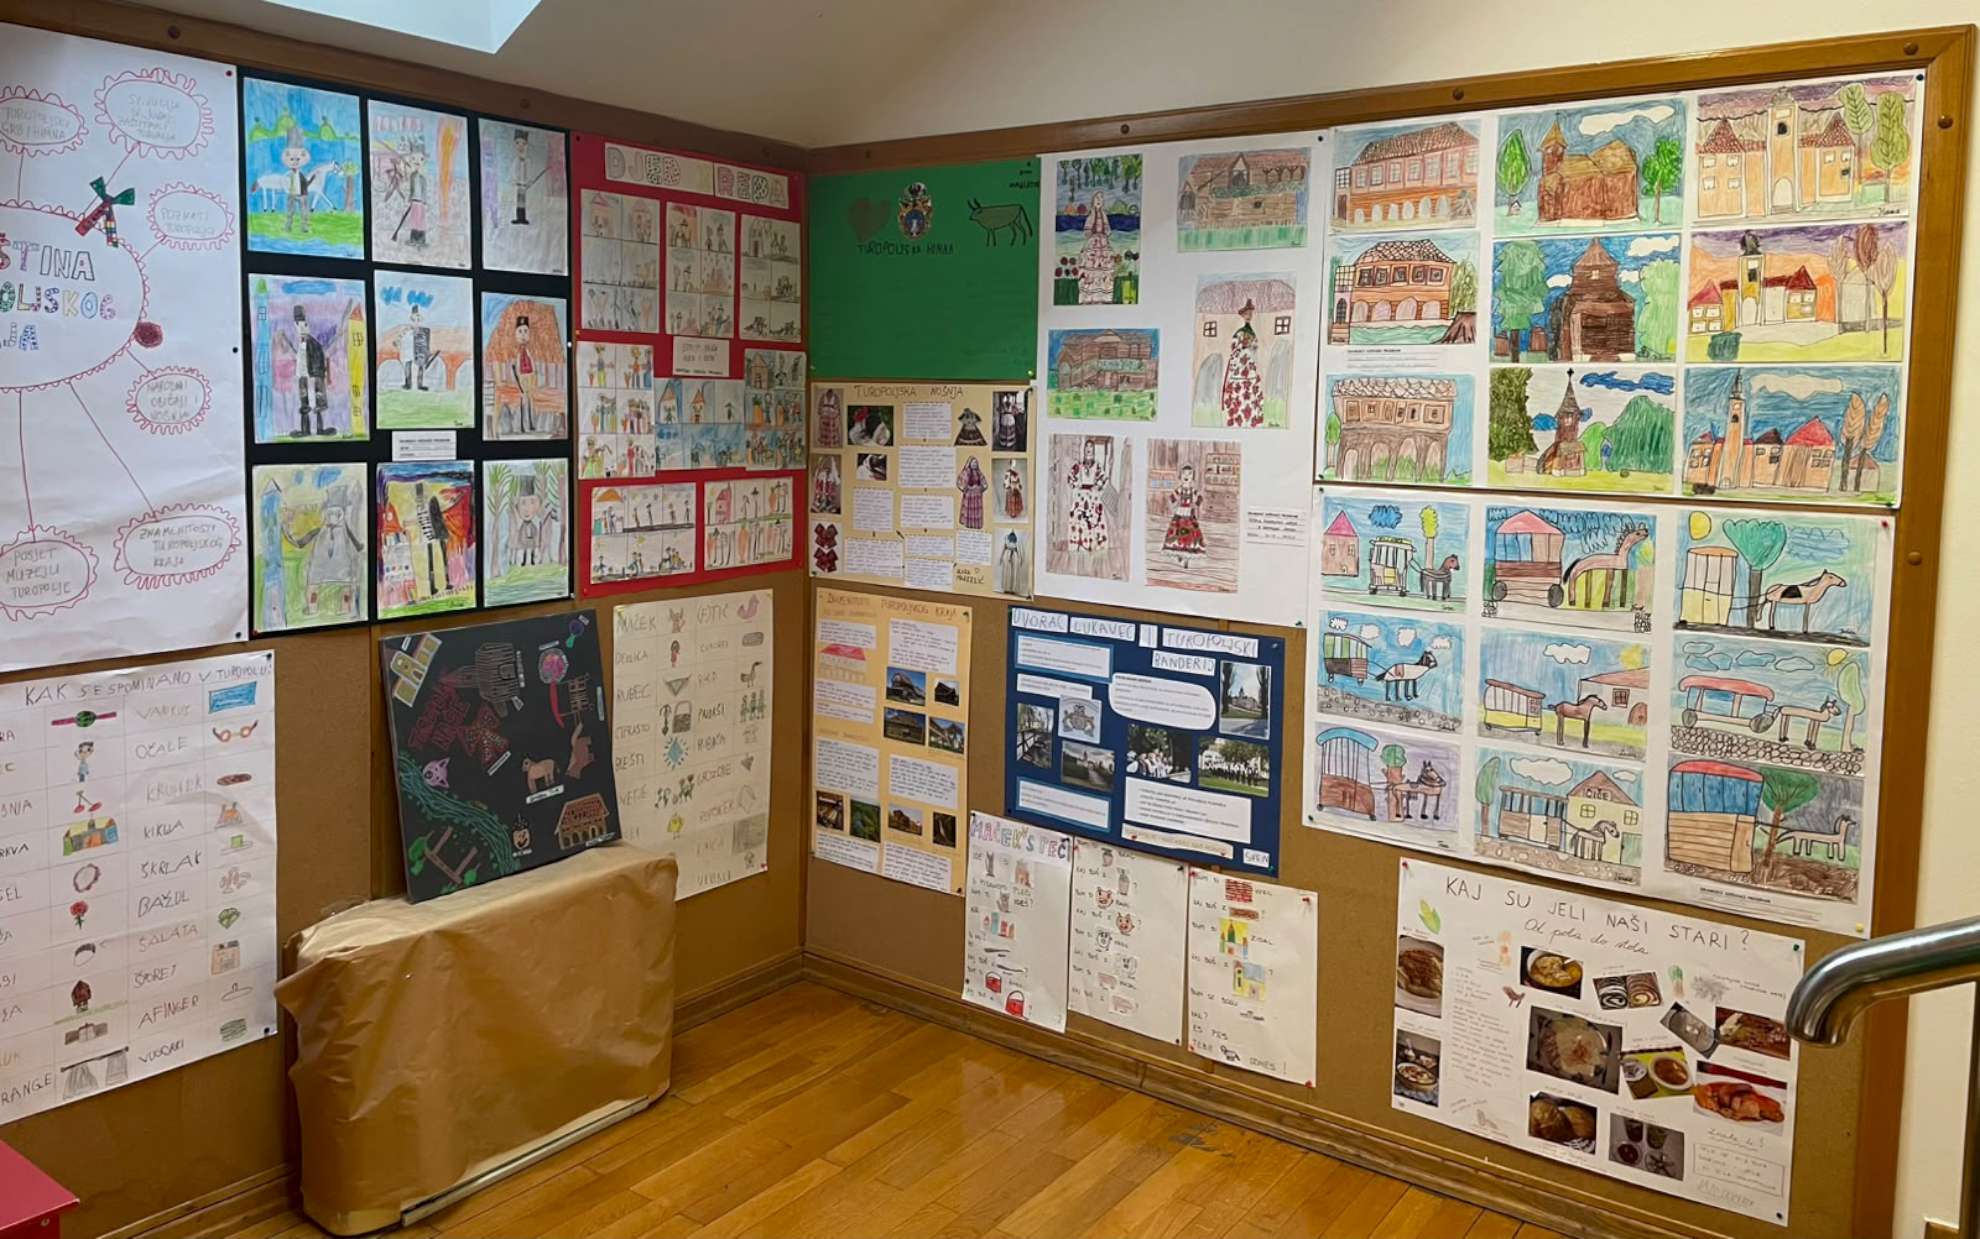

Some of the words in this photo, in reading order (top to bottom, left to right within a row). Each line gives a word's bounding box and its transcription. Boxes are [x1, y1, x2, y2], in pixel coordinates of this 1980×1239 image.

[25, 683, 68, 706] KAK
[137, 889, 191, 918] BAŽUL
[1446, 875, 1482, 901] KAJ
[1505, 890, 1532, 909] SU
[1548, 901, 1586, 921] JELI
[1606, 911, 1649, 934] NAŠI
[1669, 925, 1728, 951] STARI
[1525, 918, 1545, 934] Od
